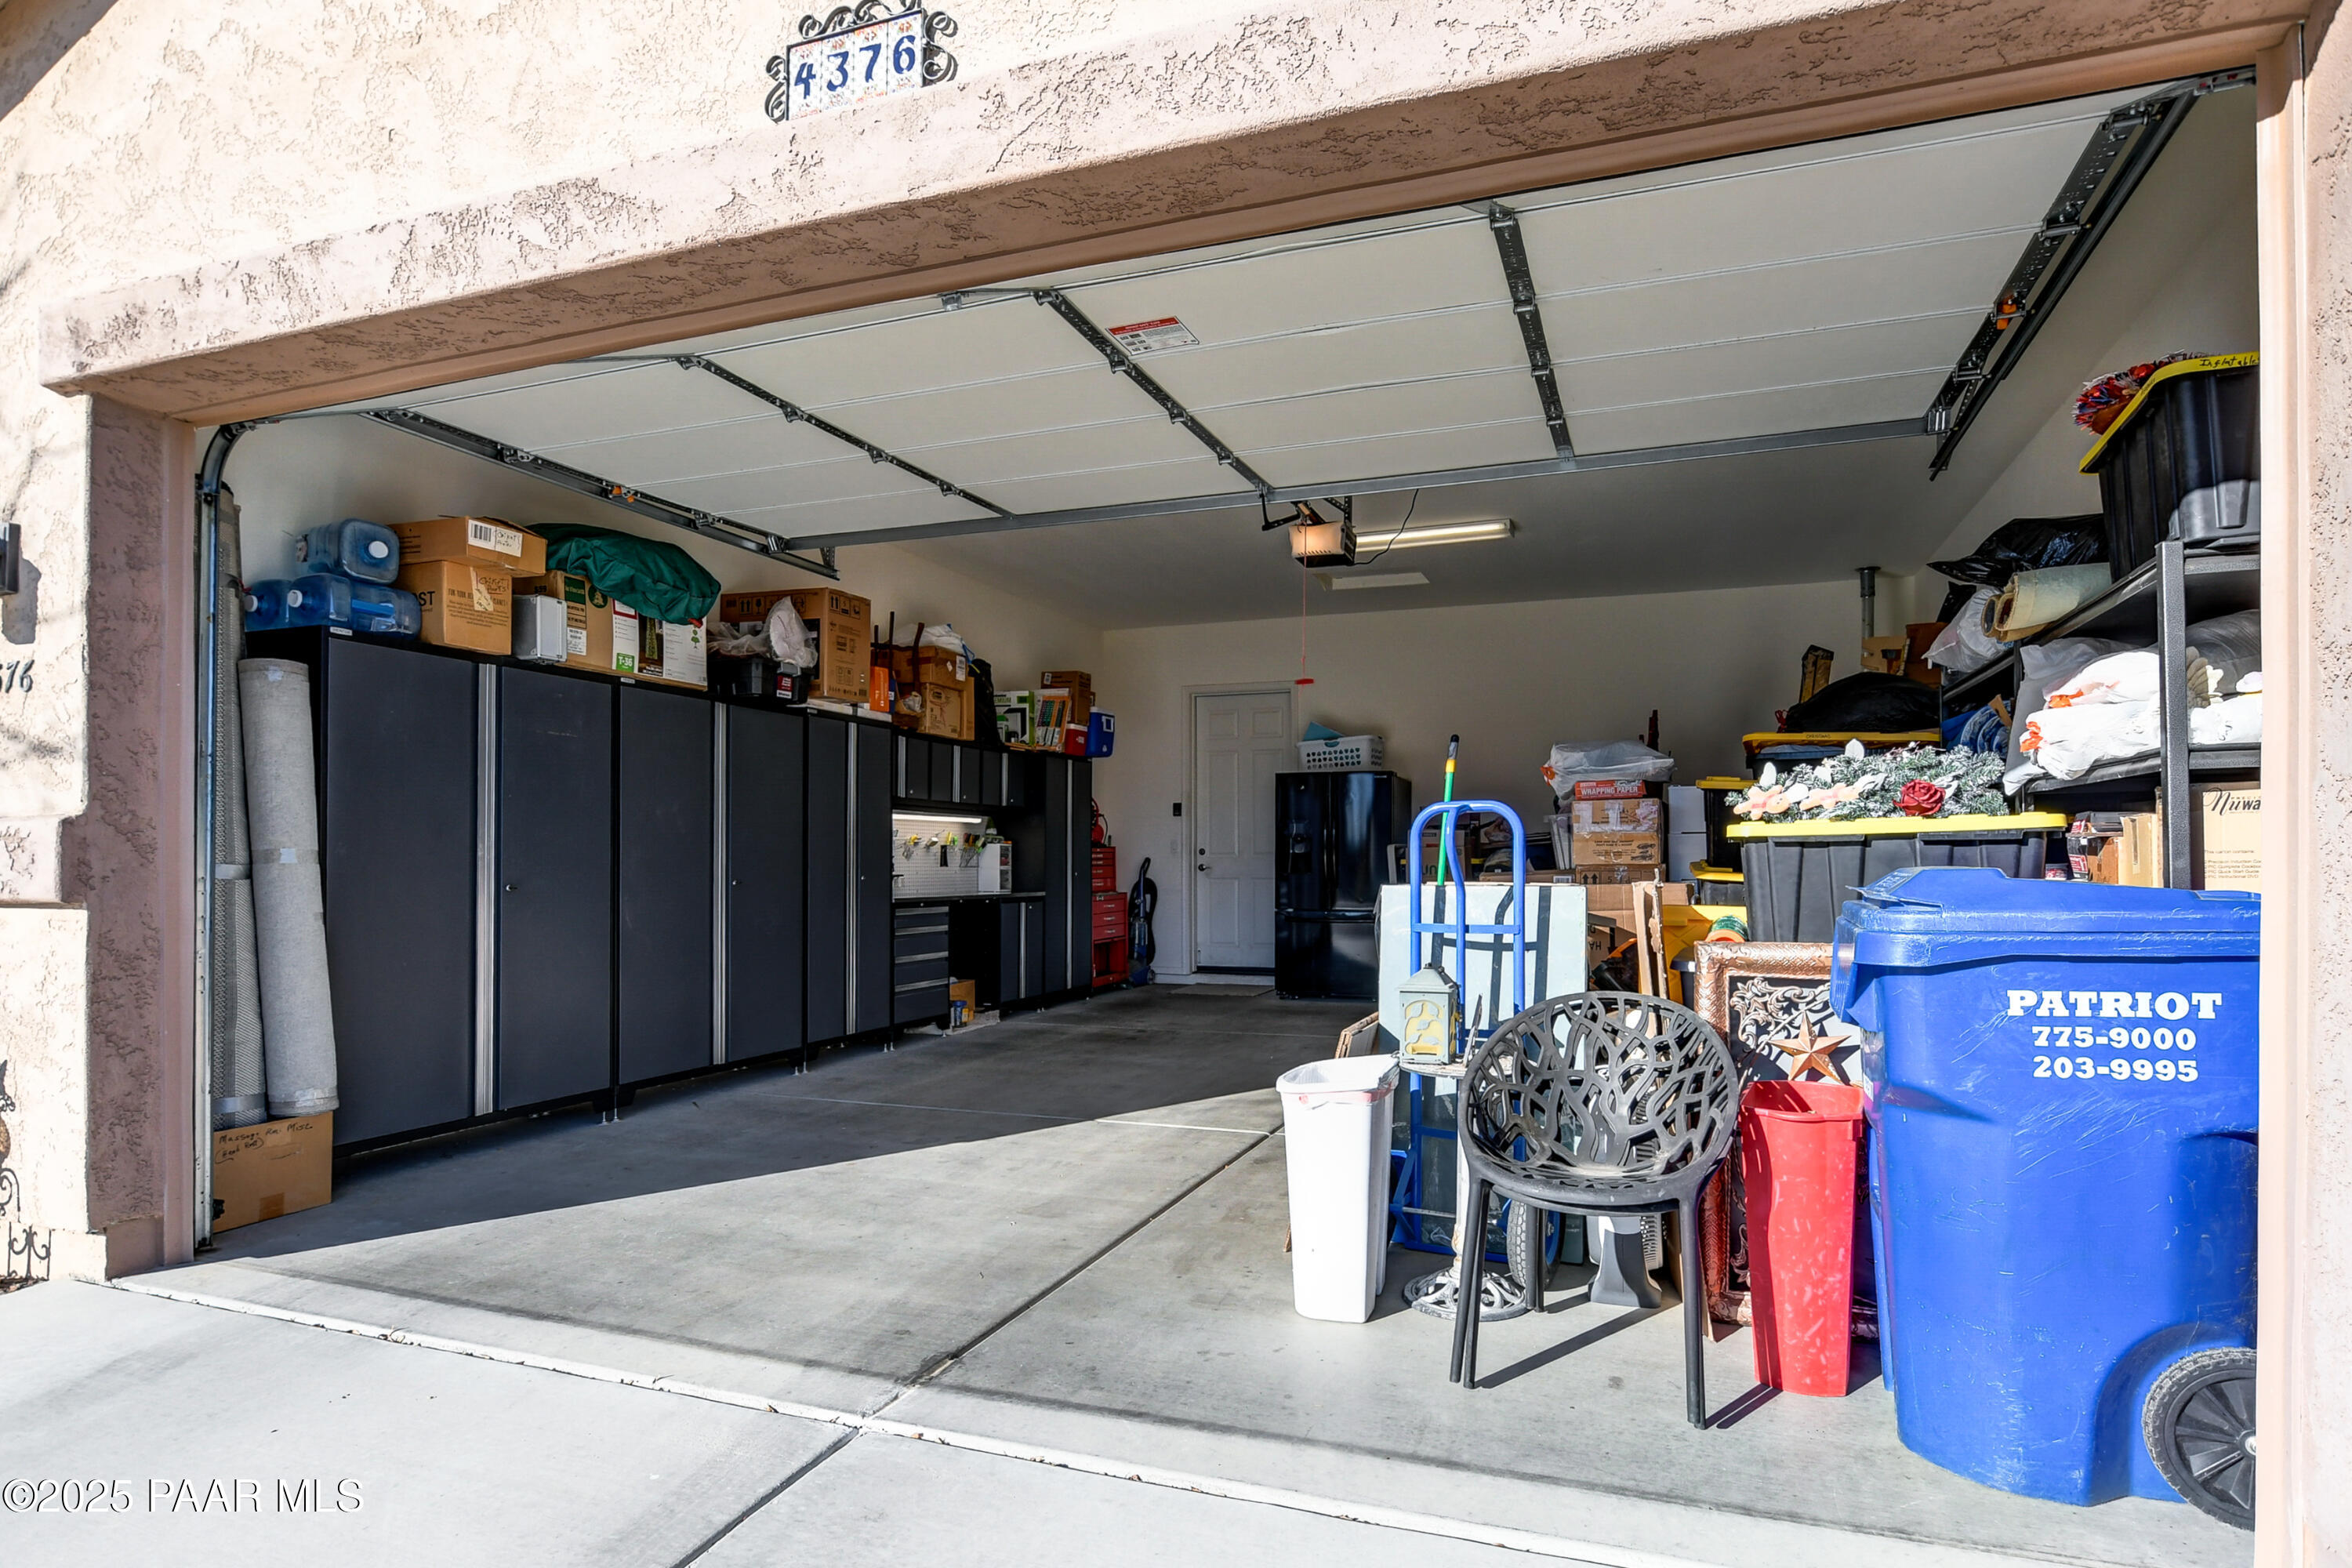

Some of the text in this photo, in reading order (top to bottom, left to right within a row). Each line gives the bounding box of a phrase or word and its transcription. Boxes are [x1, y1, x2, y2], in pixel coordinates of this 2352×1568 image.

[793, 34, 916, 100] 4376
[0, 659, 34, 694] 76
[1581, 786, 1638, 796] WRAPPING PAPER
[2006, 989, 2223, 1021] PATRIOT
[2031, 1025, 2197, 1051] 775-9000
[2032, 1055, 2199, 1083] 203-9995
